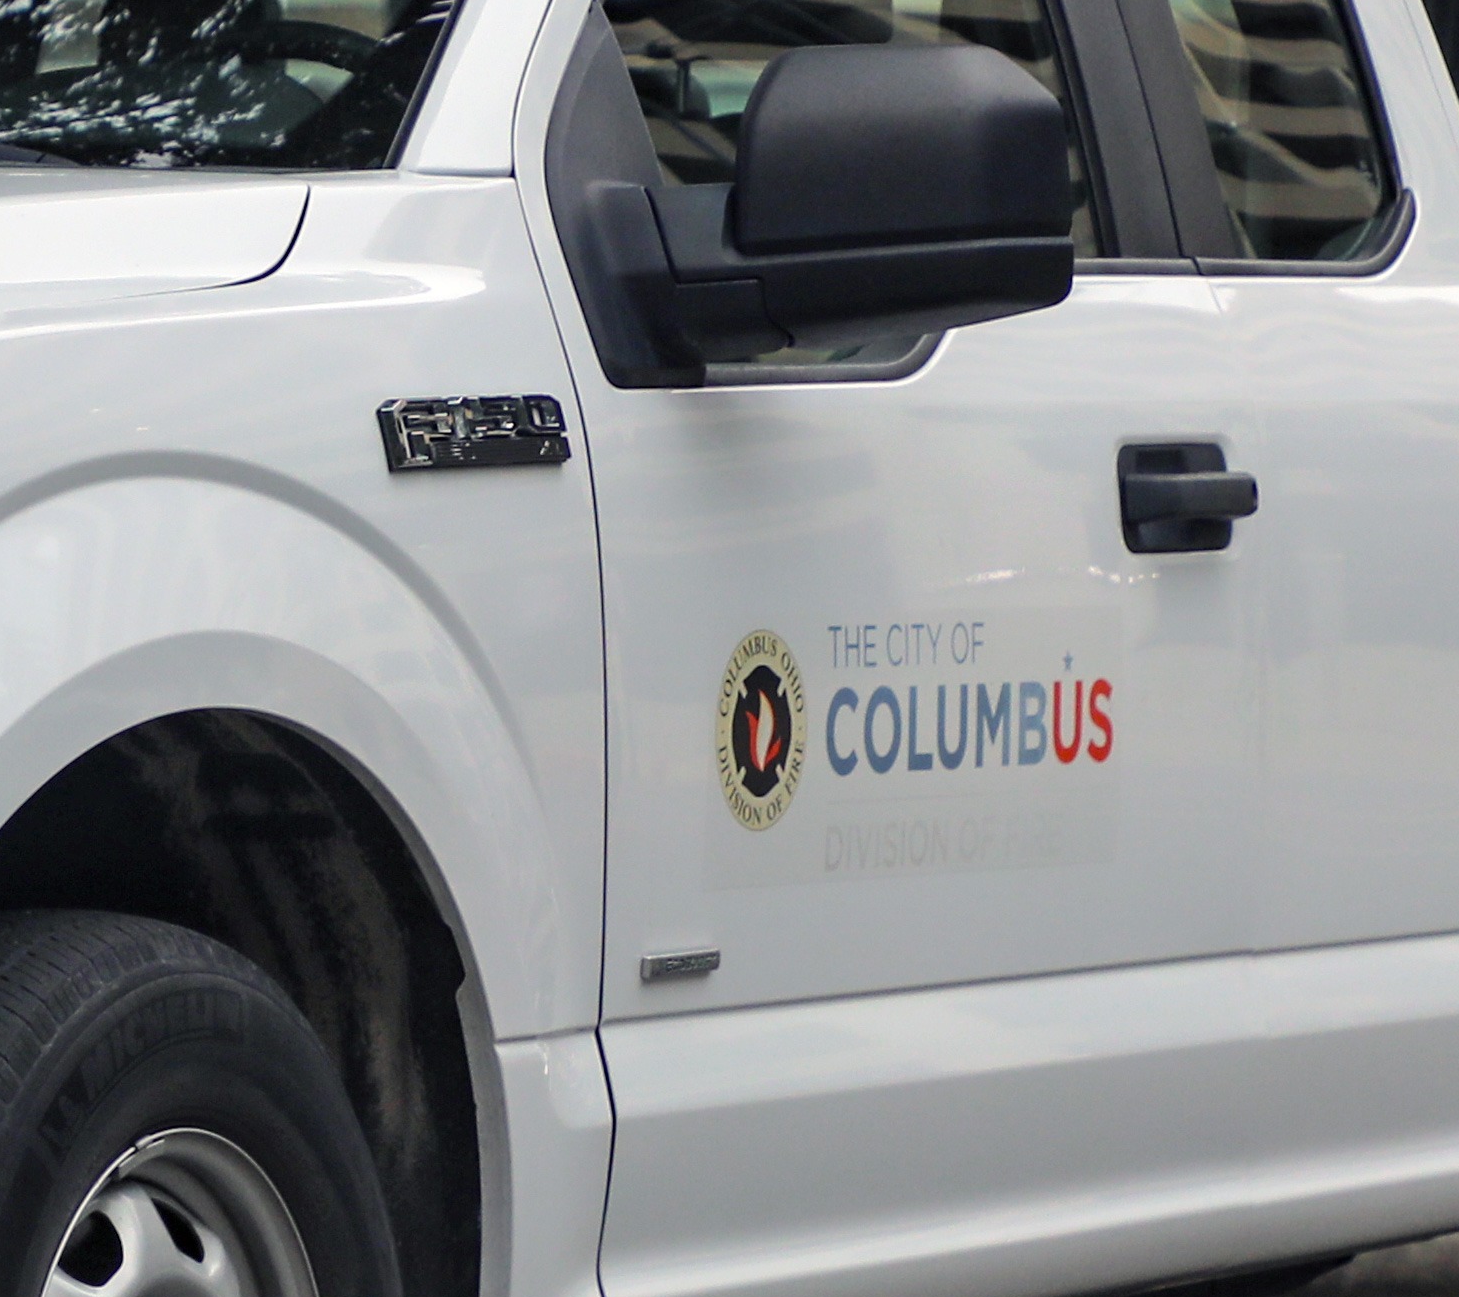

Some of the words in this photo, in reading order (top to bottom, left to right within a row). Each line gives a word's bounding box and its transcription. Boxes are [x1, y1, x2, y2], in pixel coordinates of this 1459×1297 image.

[719, 634, 779, 717] COLUMBUS
[780, 651, 806, 713] OHIO
[827, 625, 878, 668] THE
[886, 623, 943, 666] CITY
[950, 621, 985, 664] OF
[826, 678, 1113, 776] COLUMBUS
[718, 744, 763, 825] DIVISION
[765, 793, 784, 822] OF
[784, 740, 806, 796] FIRE
[824, 819, 951, 873] DIVISION
